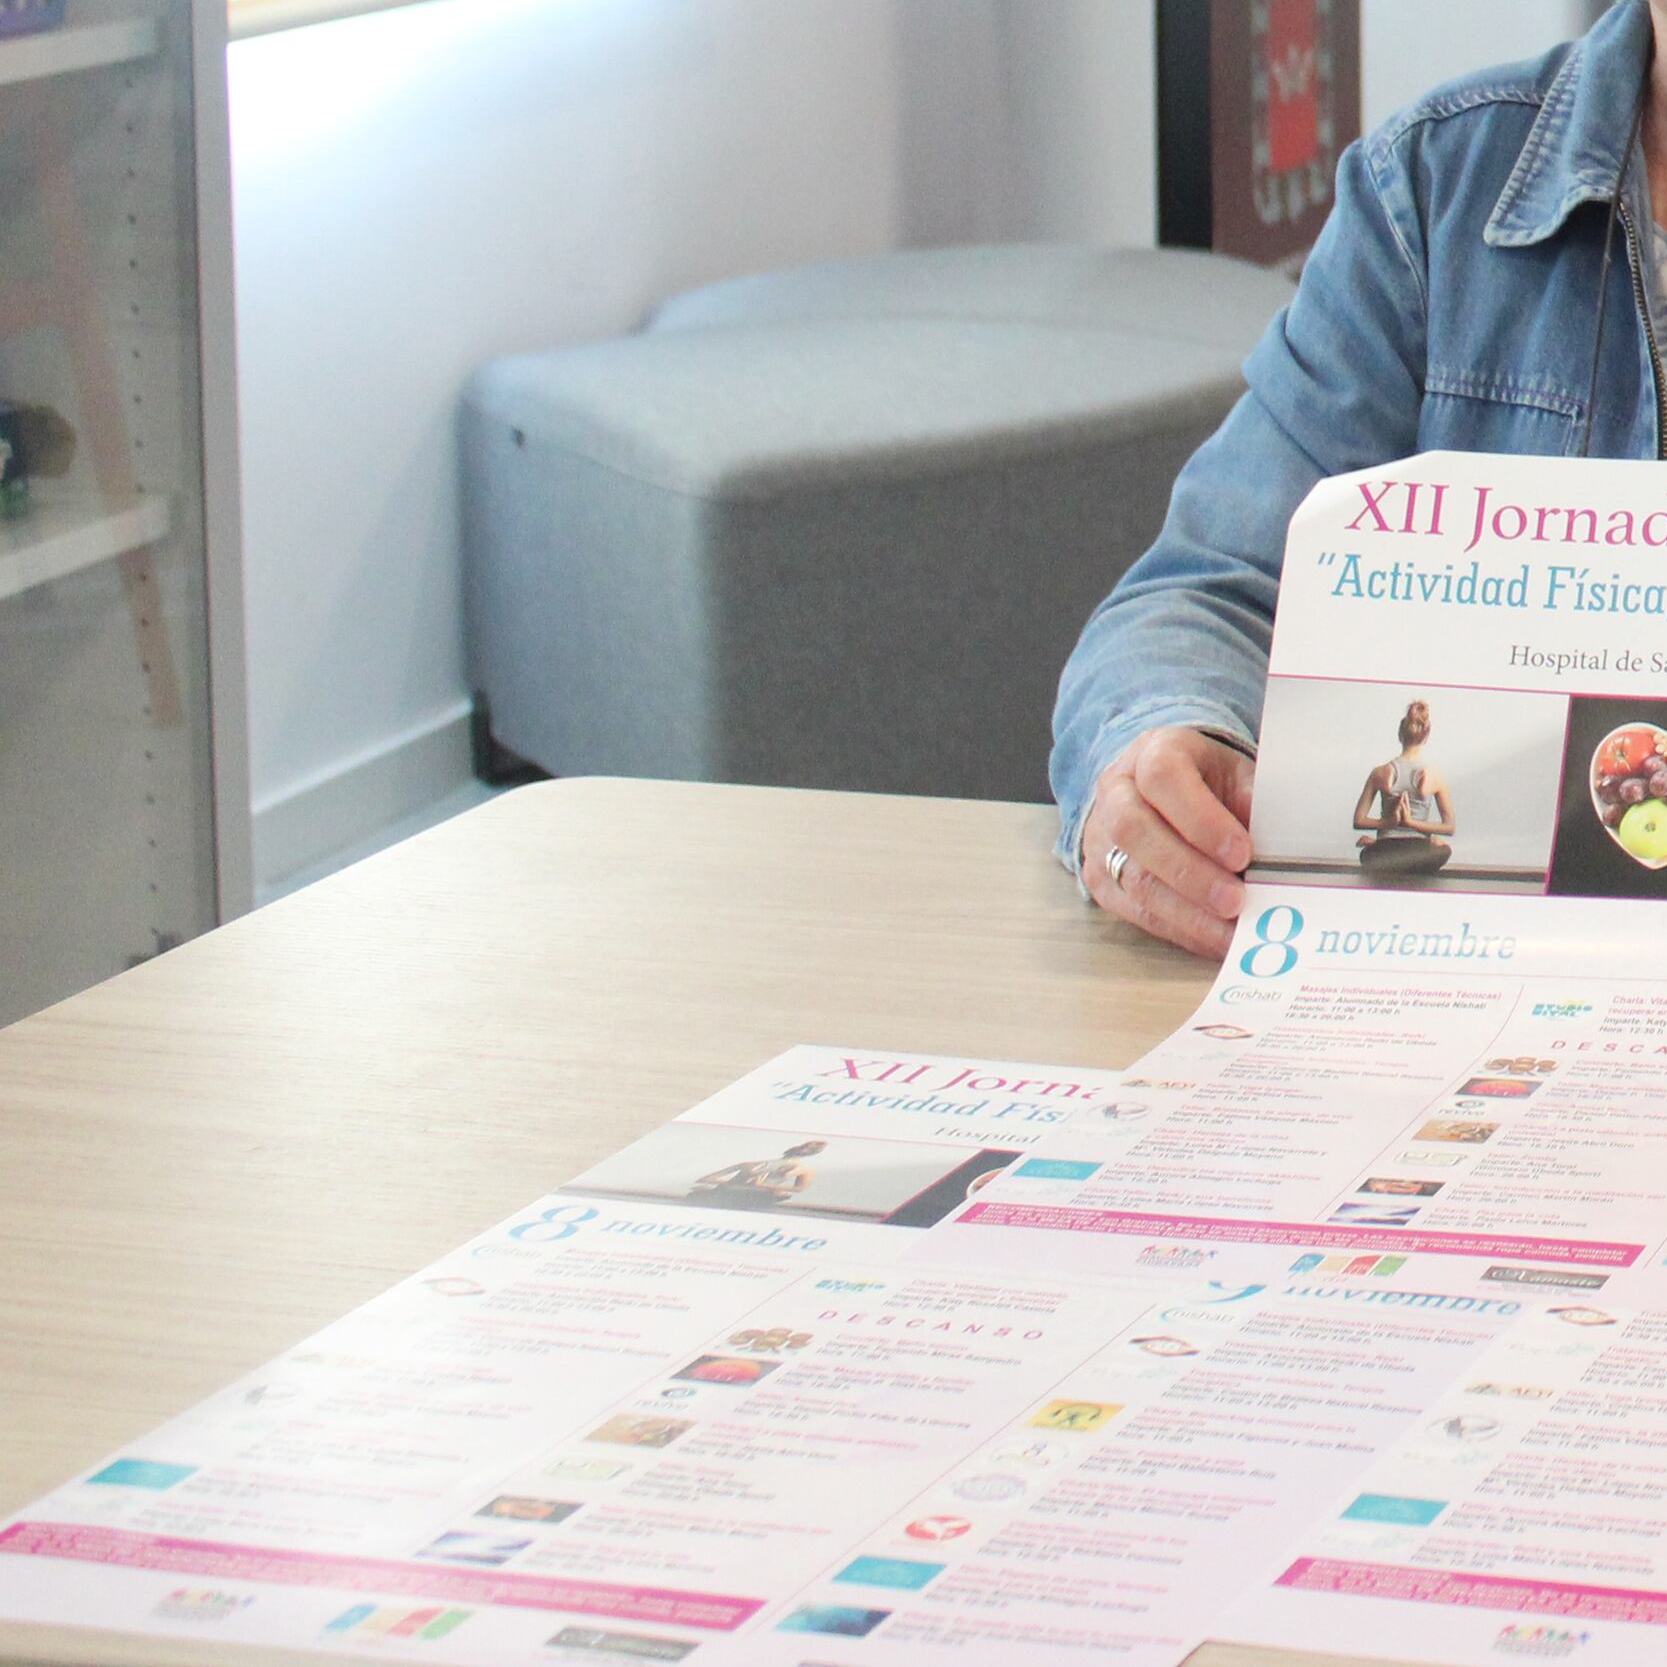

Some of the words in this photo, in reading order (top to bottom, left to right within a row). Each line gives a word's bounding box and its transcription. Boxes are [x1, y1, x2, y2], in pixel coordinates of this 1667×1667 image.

[1344, 480, 1450, 535] XII
[1510, 645, 1607, 675] Hospital
[1616, 650, 1643, 672] de
[1239, 905, 1304, 977] 8
[1316, 923, 1512, 958] noviembre
[816, 1056, 940, 1084] XII
[934, 1126, 1041, 1145] Hospital
[508, 1203, 601, 1245] 8
[600, 1216, 829, 1254] noviembre
